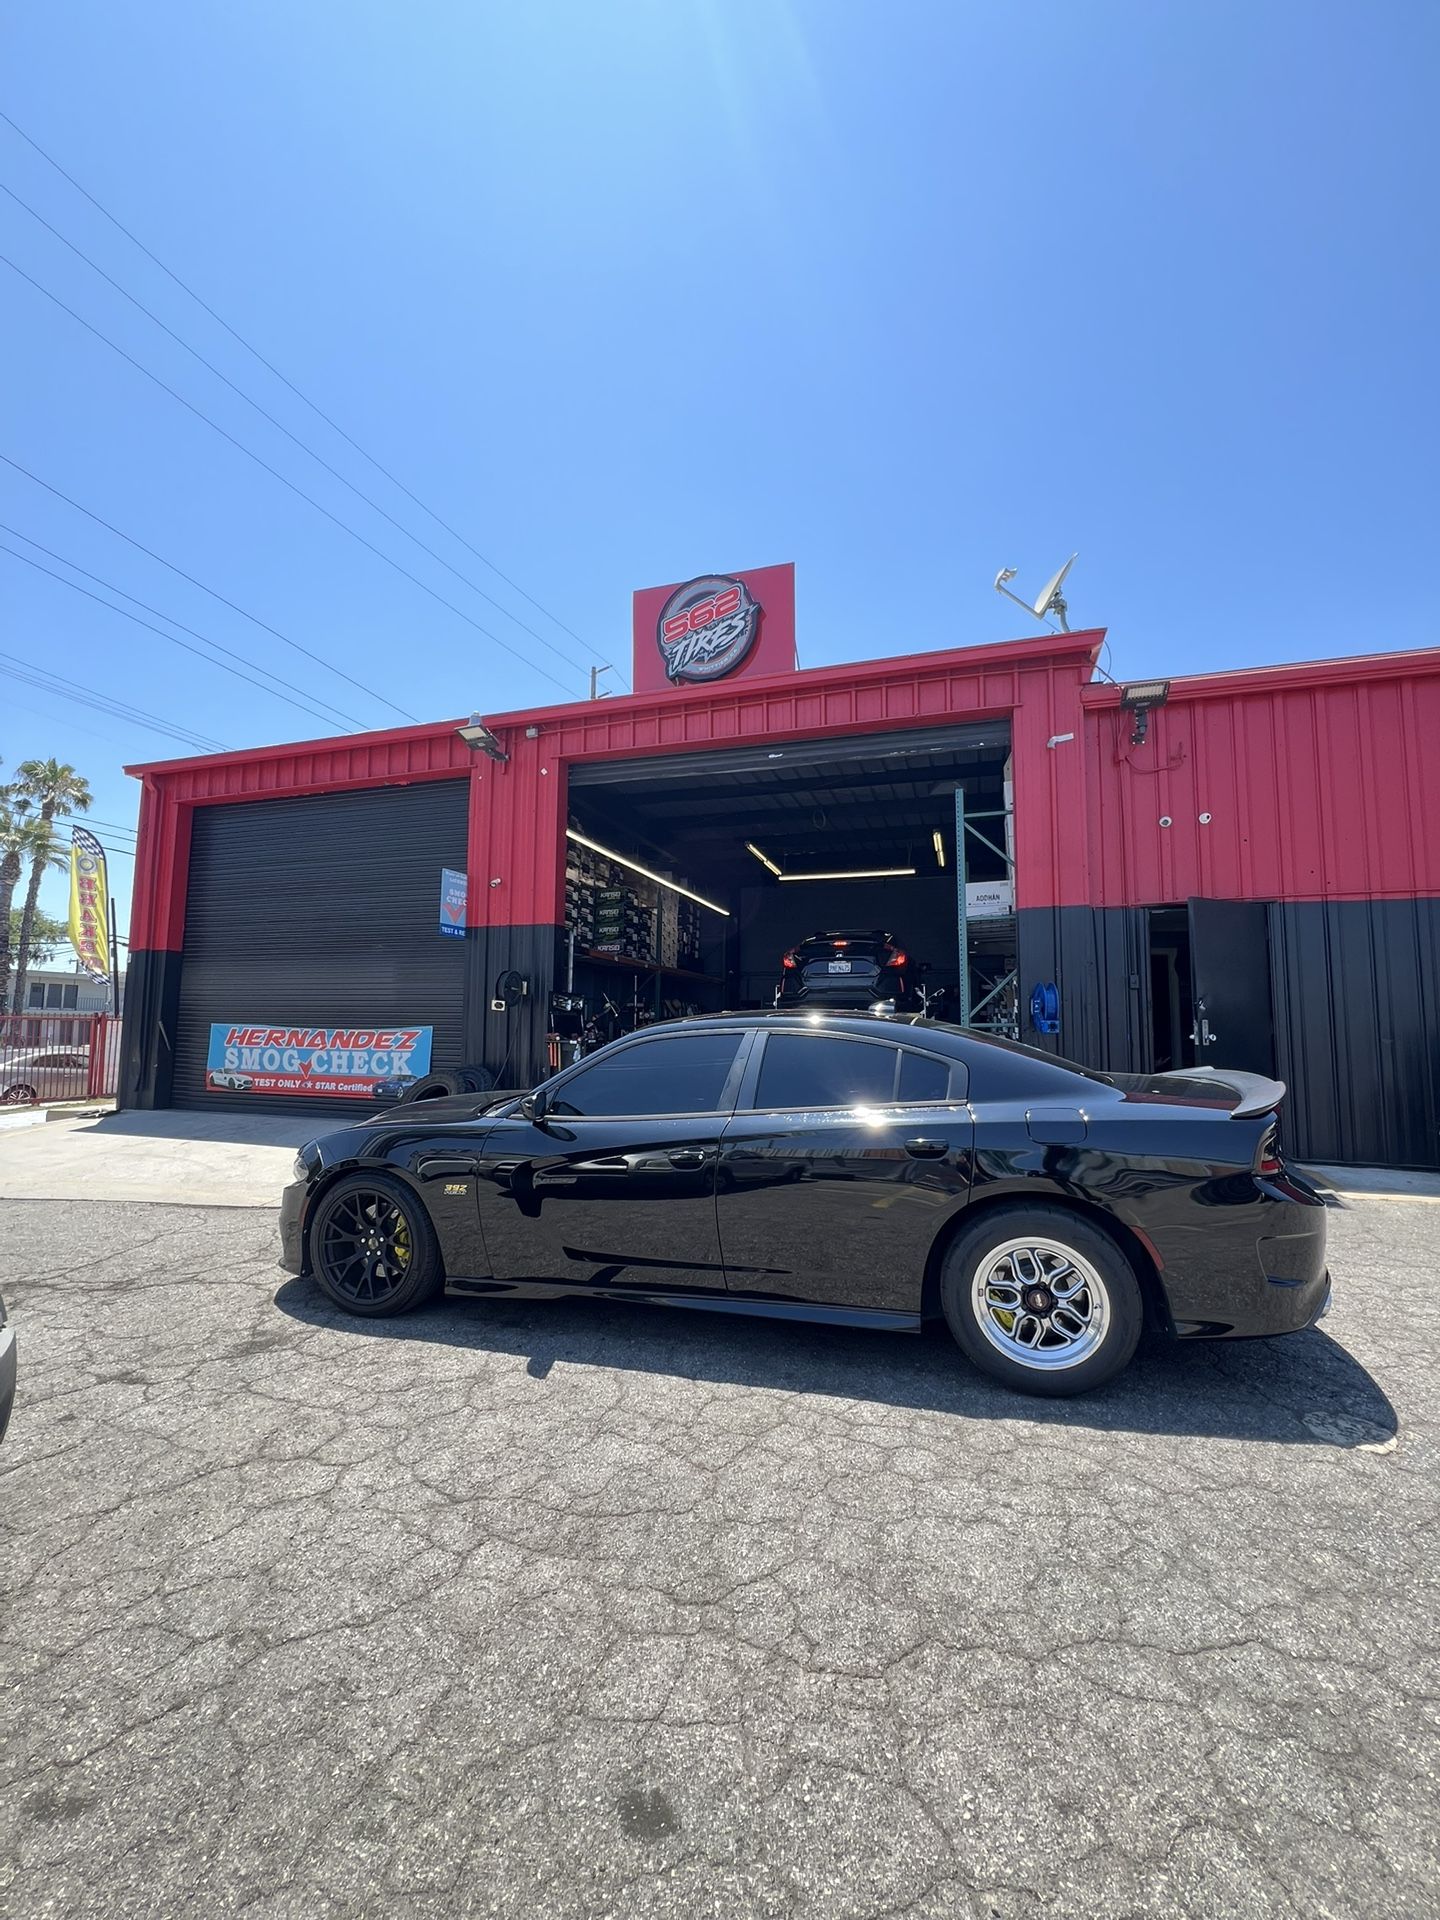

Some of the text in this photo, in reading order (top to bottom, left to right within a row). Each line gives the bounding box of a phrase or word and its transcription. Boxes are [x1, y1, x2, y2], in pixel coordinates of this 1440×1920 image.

[663, 586, 741, 643] 562
[669, 609, 748, 672] TIRES
[446, 895, 467, 906] CHEC
[449, 888, 466, 898] SMO
[224, 1027, 422, 1051] HERNANDEZ
[225, 1048, 412, 1076] SMOG CHECK
[254, 1078, 373, 1092] TEST ONLY STAR Certified
